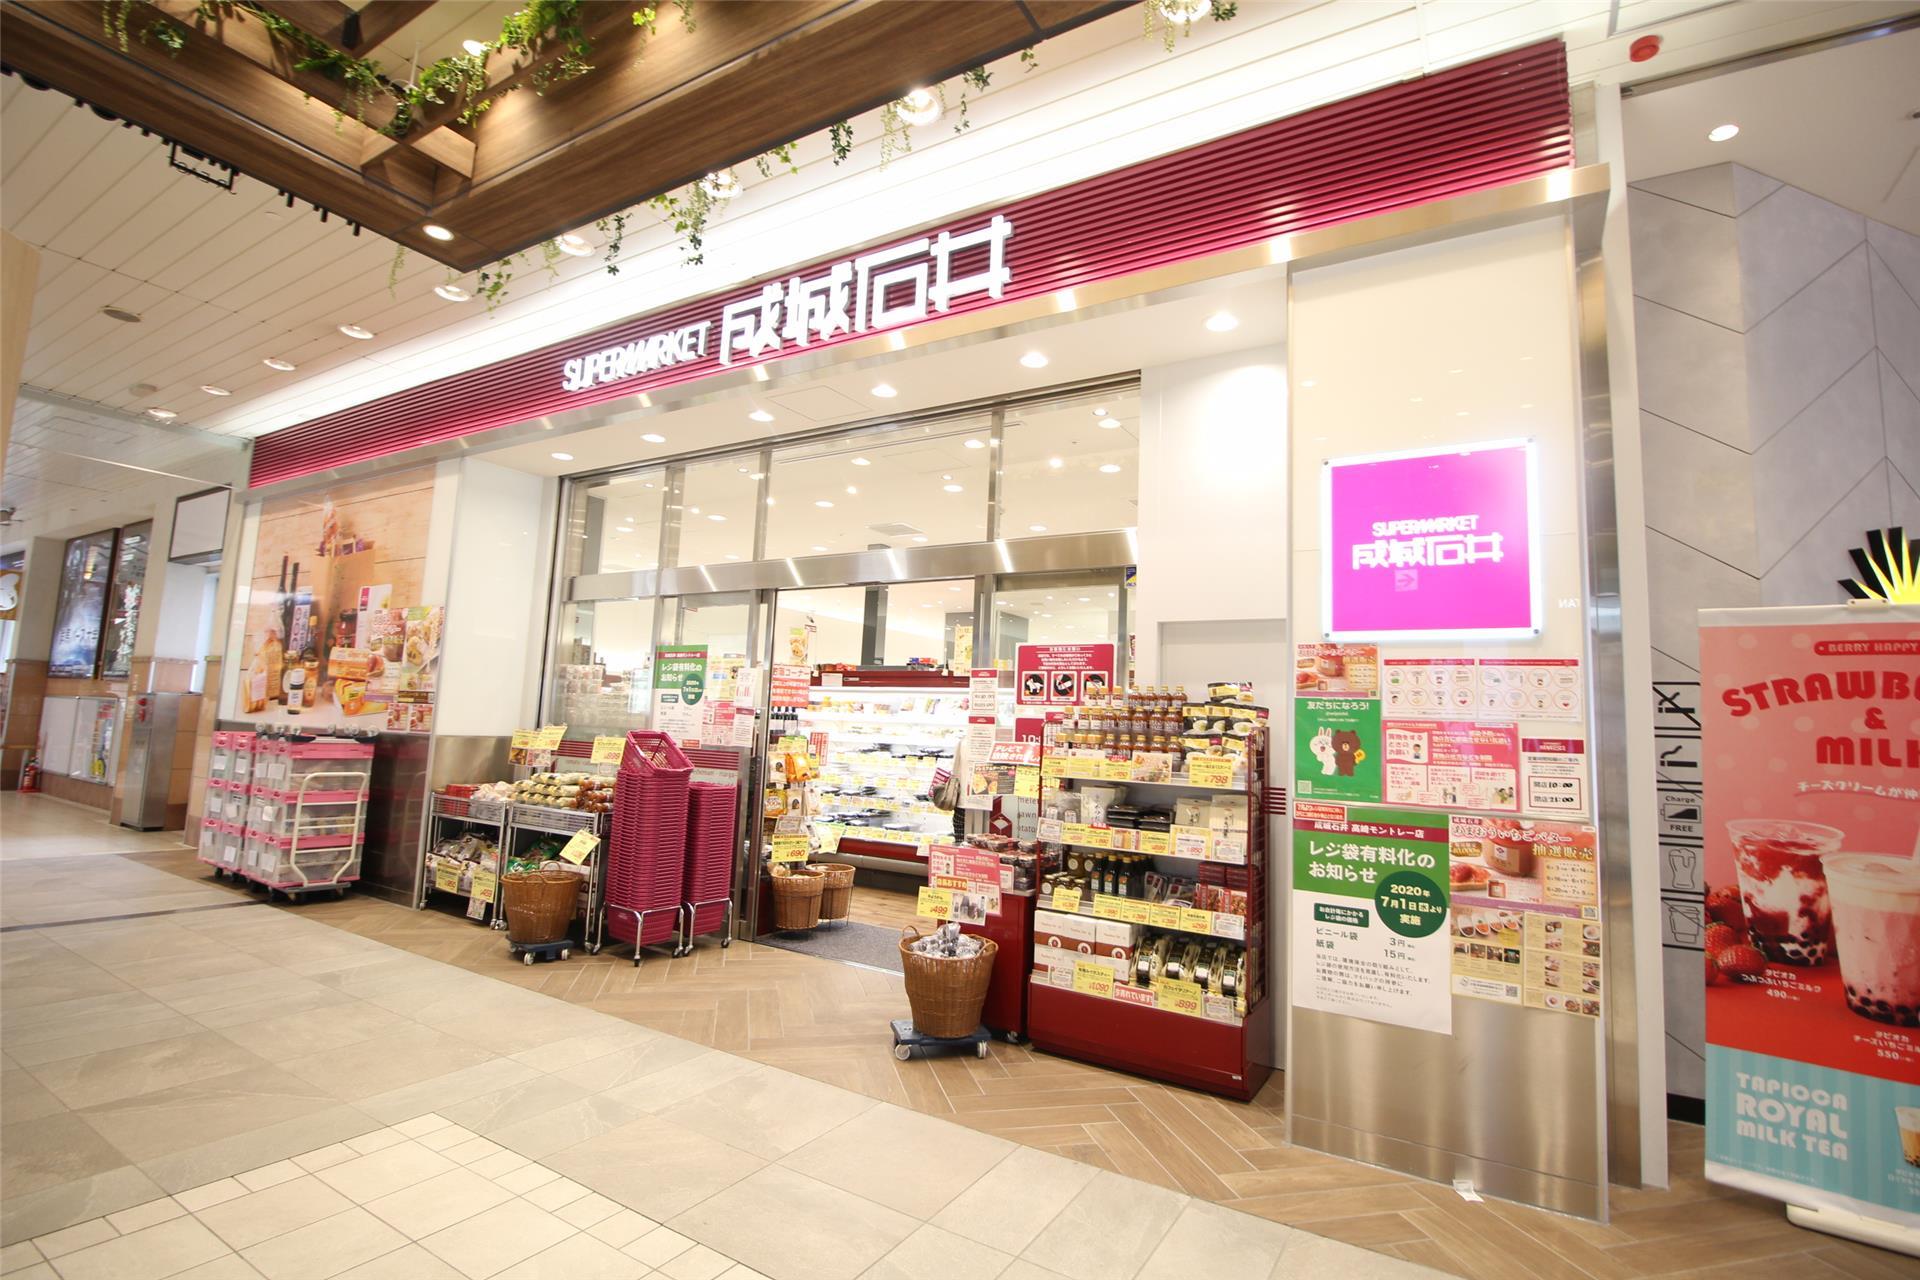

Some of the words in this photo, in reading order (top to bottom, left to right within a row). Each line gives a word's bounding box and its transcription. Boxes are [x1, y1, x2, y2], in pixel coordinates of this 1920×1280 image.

[562, 320, 712, 391] SUPERMARKET
[719, 214, 1014, 366] 成城石井
[1371, 514, 1480, 537] SUPERMARKET
[1351, 531, 1505, 571] 成城石井
[1828, 643, 1870, 652] BERRY
[1722, 670, 1920, 717] STRAWB
[1864, 707, 1888, 730] &
[1665, 795, 1696, 804] Charge
[1308, 840, 1436, 869] レジ袋有料化の
[1308, 861, 1377, 884] お知らせ
[1390, 883, 1431, 897] 2020年
[1383, 948, 1406, 961] 15円
[1735, 1071, 1849, 1112] TAPIOCA
[1735, 1092, 1848, 1139] ROYAL
[1735, 1119, 1797, 1149] MILK
[1802, 1133, 1848, 1161] TEA
